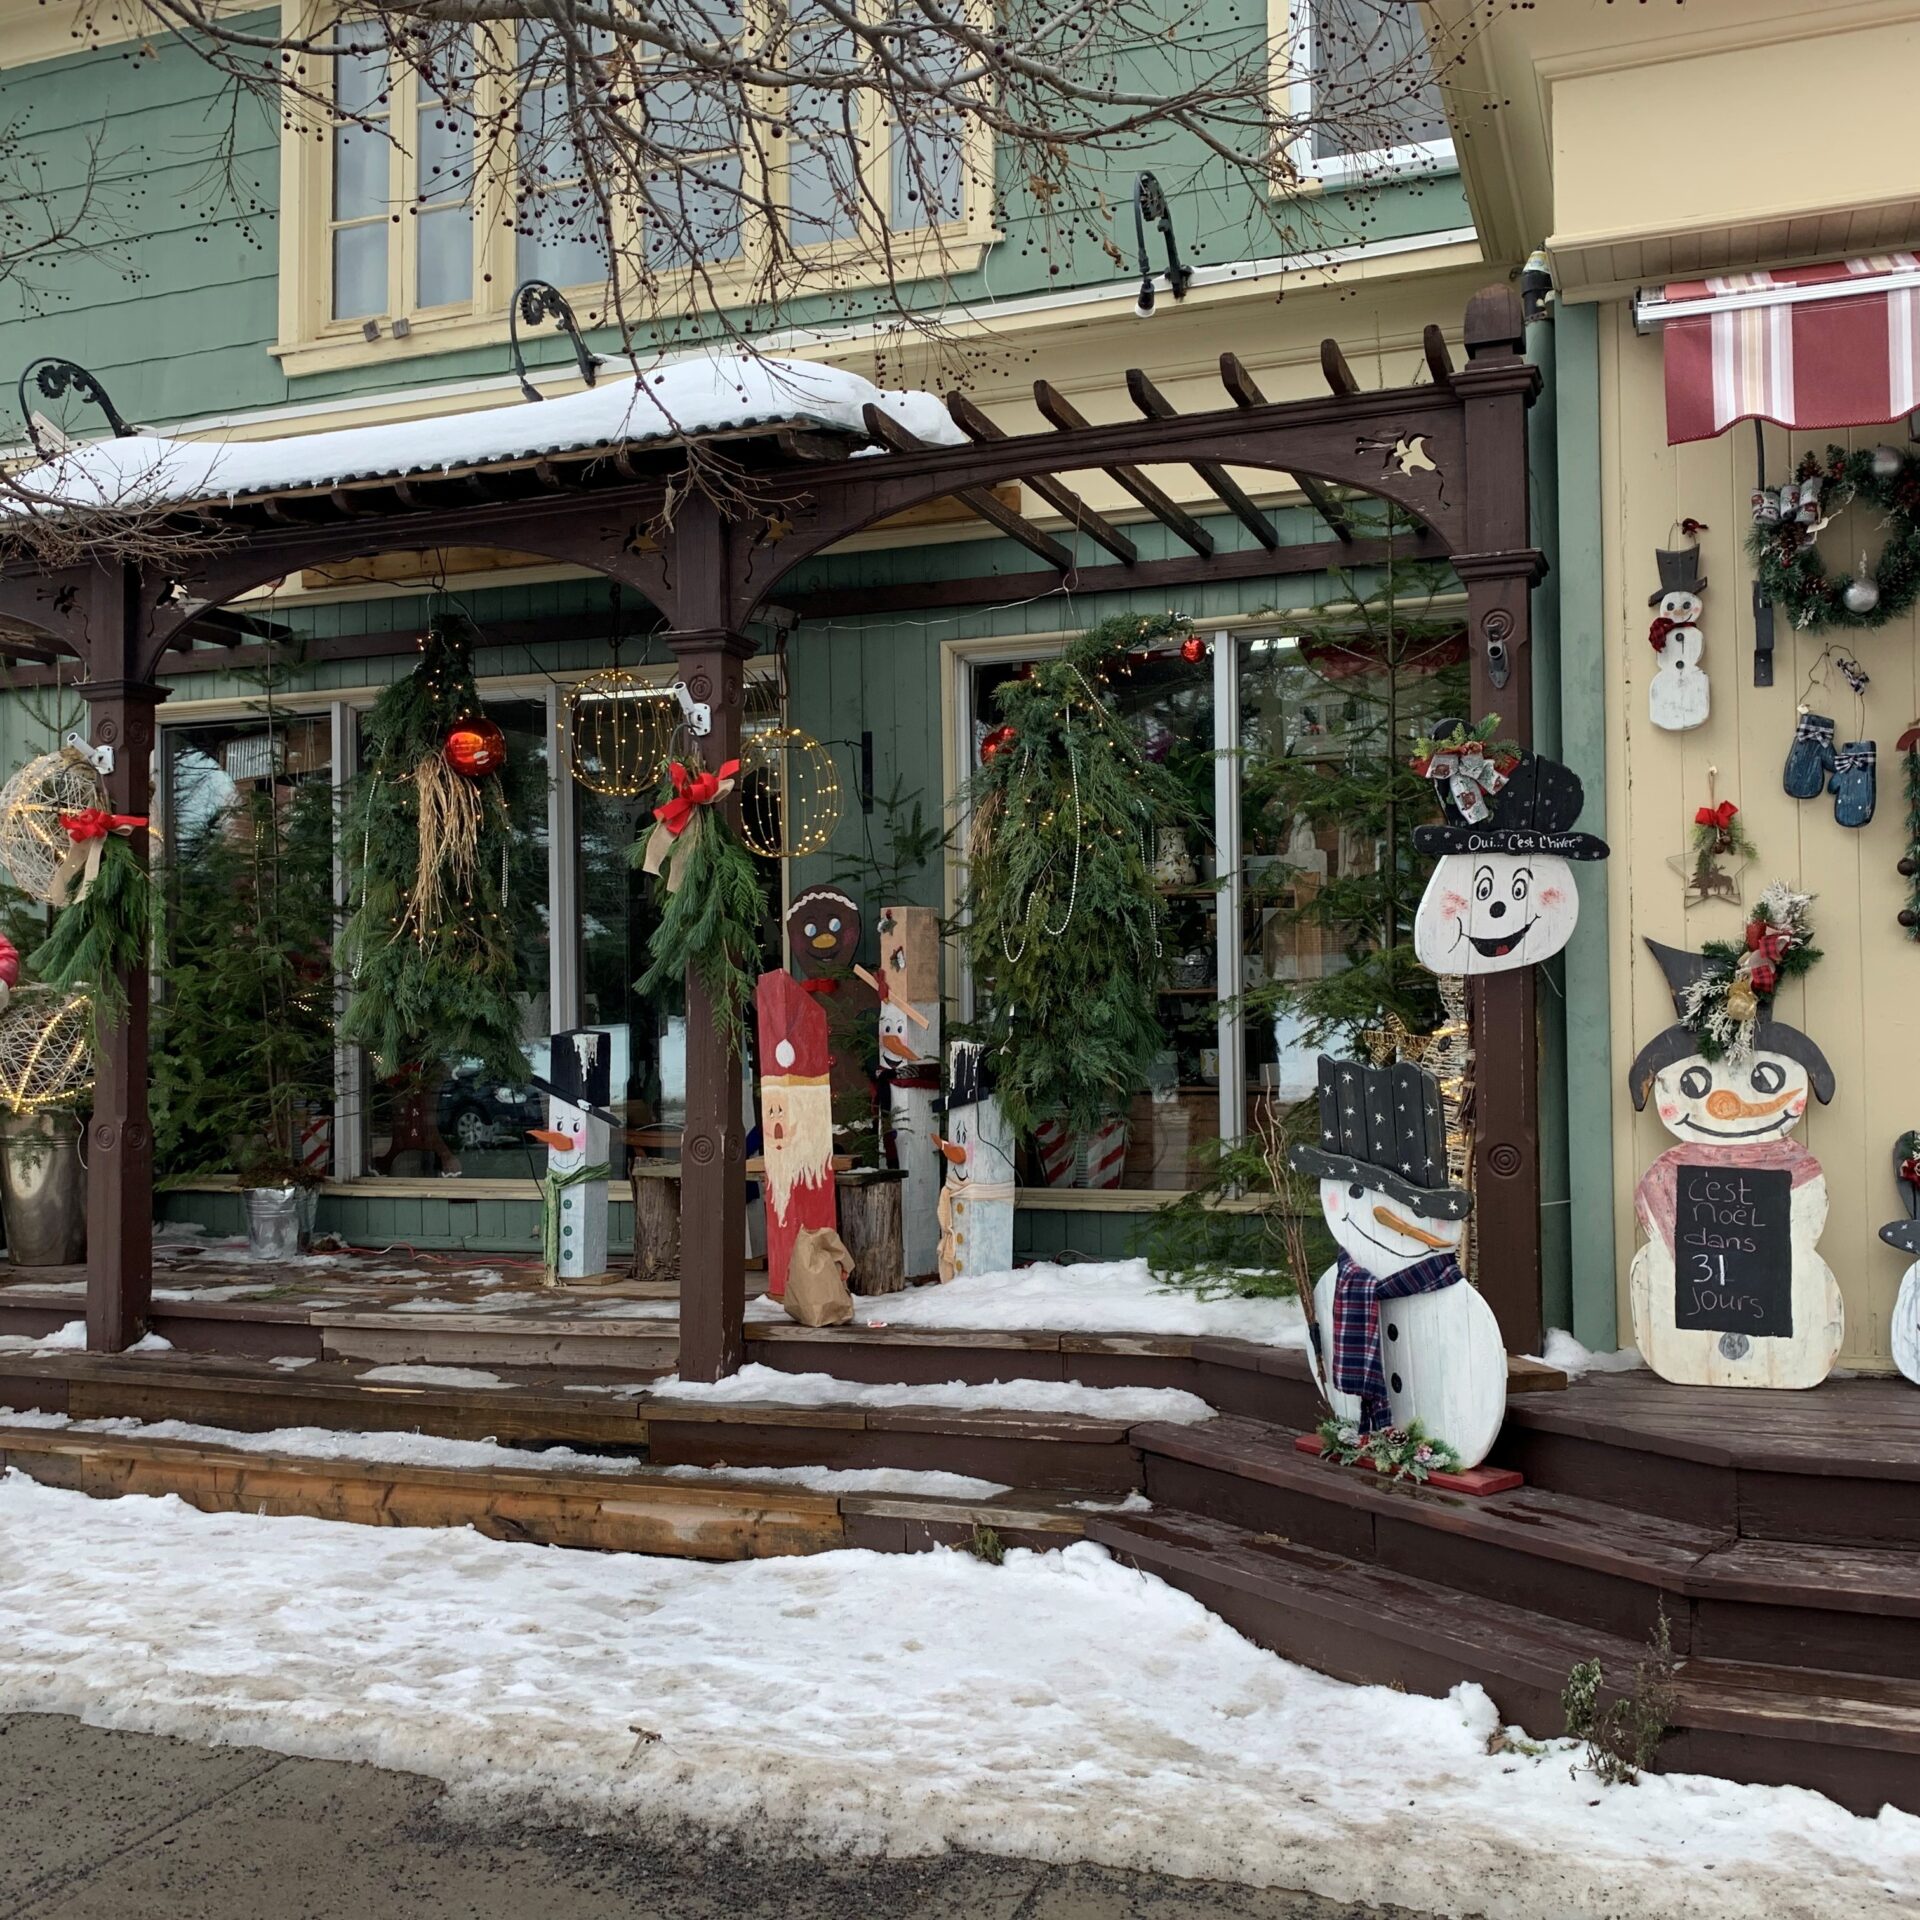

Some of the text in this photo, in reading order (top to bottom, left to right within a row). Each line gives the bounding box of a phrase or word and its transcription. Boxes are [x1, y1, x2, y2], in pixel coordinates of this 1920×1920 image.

[1468, 834, 1503, 850] Oui...
[1507, 834, 1534, 850] C'est
[1684, 1228, 1756, 1252] dans
